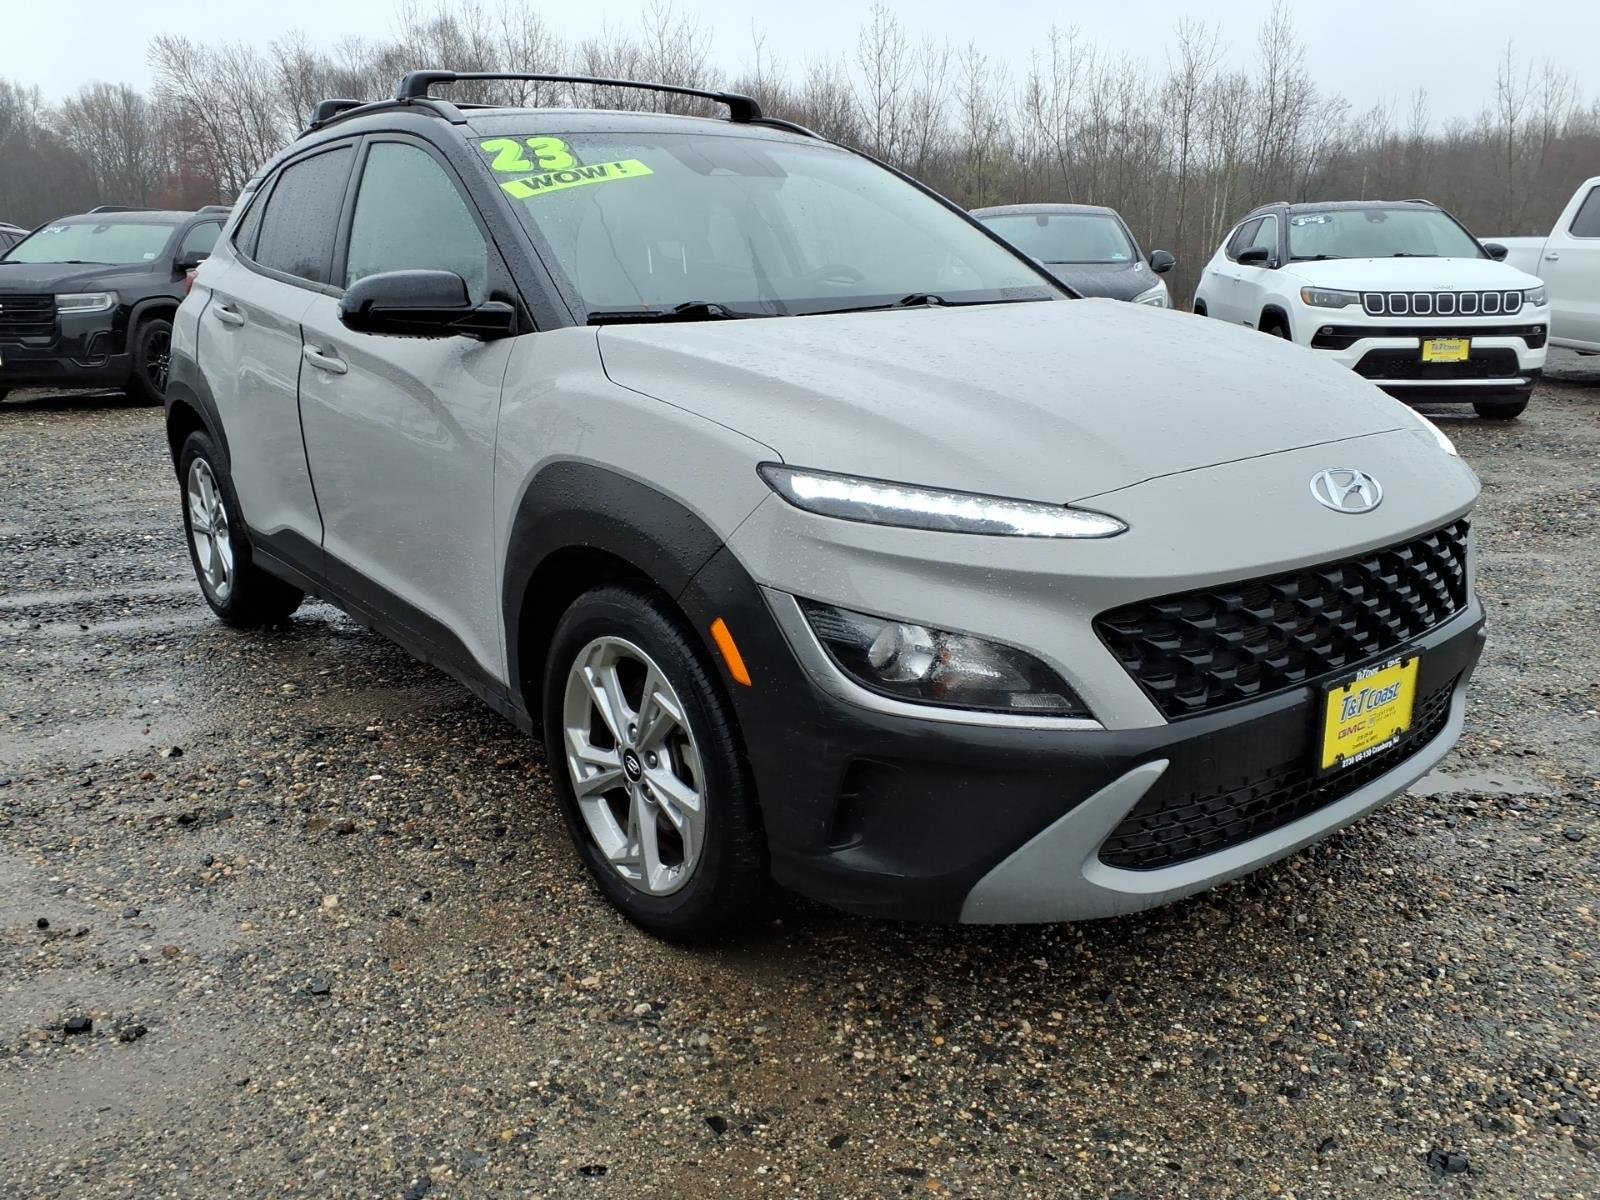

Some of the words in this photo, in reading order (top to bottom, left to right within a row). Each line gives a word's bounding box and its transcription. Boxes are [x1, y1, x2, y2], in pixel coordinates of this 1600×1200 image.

[480, 137, 579, 173] 23
[1340, 688, 1369, 723] T&T
[1366, 681, 1401, 712] Coast
[1337, 720, 1367, 739] GMC
